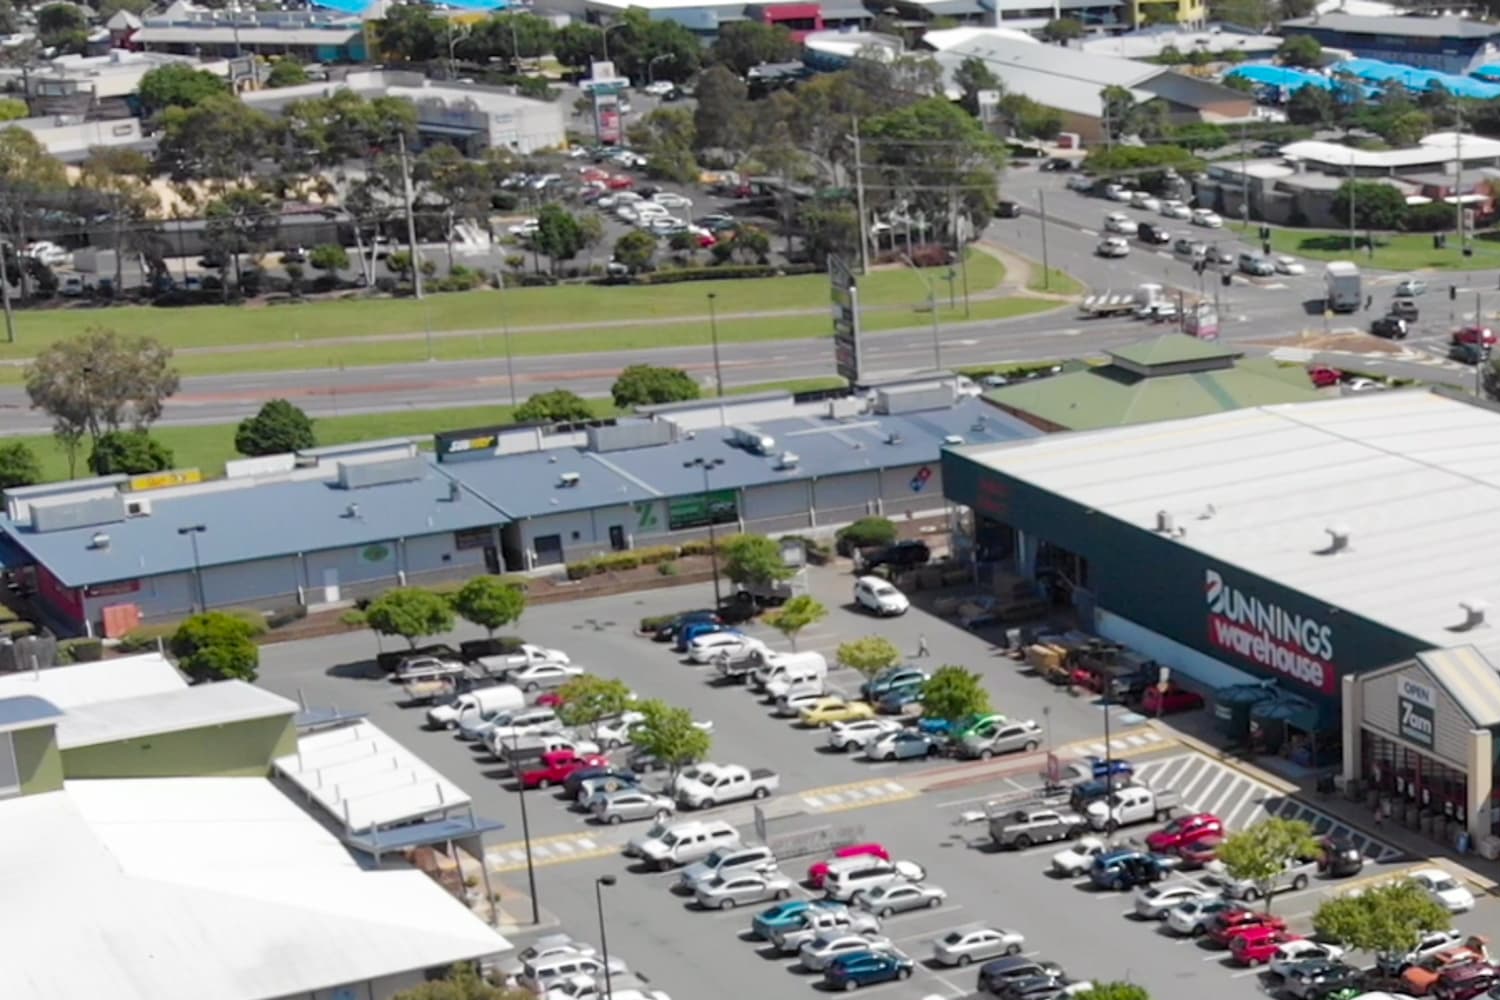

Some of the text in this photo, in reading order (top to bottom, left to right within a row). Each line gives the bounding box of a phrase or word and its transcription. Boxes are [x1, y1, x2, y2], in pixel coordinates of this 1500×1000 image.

[1205, 569, 1332, 660] BUNNINGS
[1215, 620, 1324, 688] warehouse
[1402, 700, 1432, 734] 7am
[1404, 681, 1430, 702] OPEN
